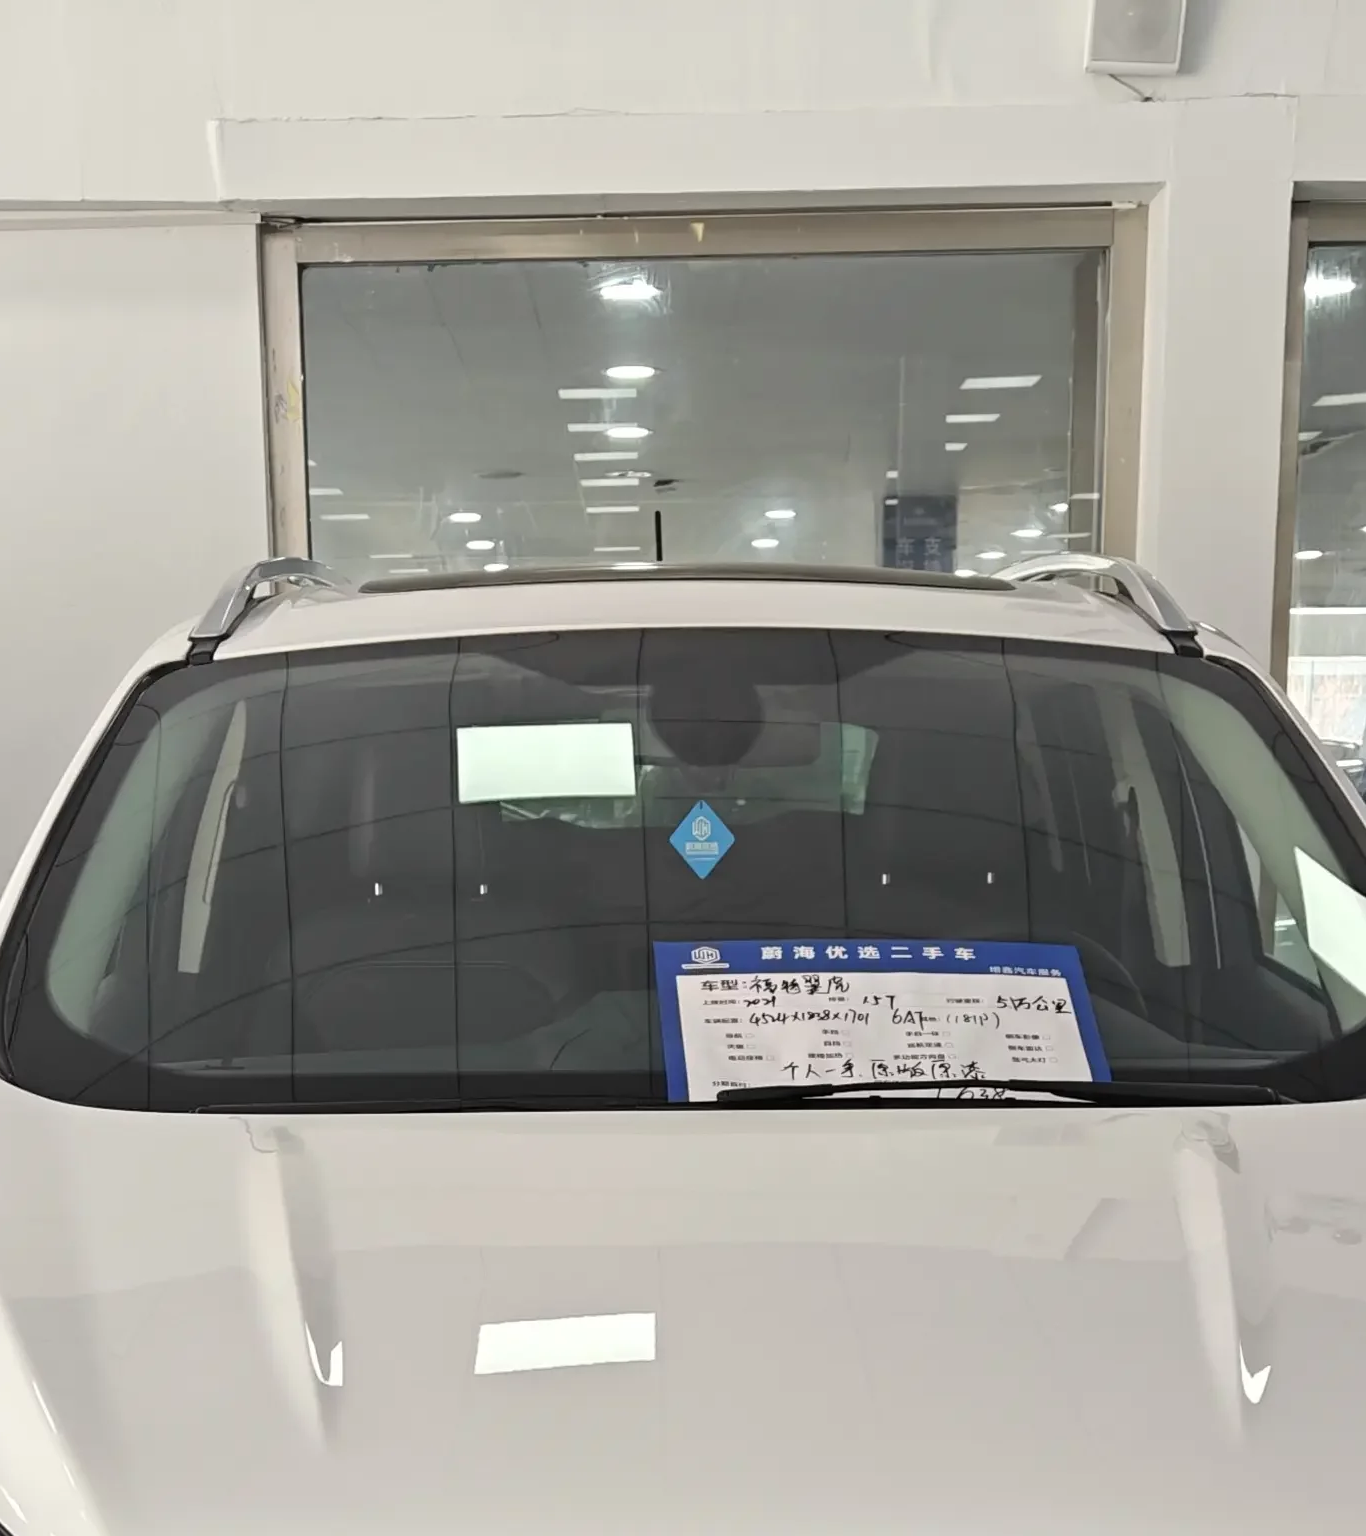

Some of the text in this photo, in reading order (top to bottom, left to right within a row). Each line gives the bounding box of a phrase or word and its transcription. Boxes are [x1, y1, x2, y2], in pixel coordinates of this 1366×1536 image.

[760, 945, 976, 961] 蔚海优选二手车
